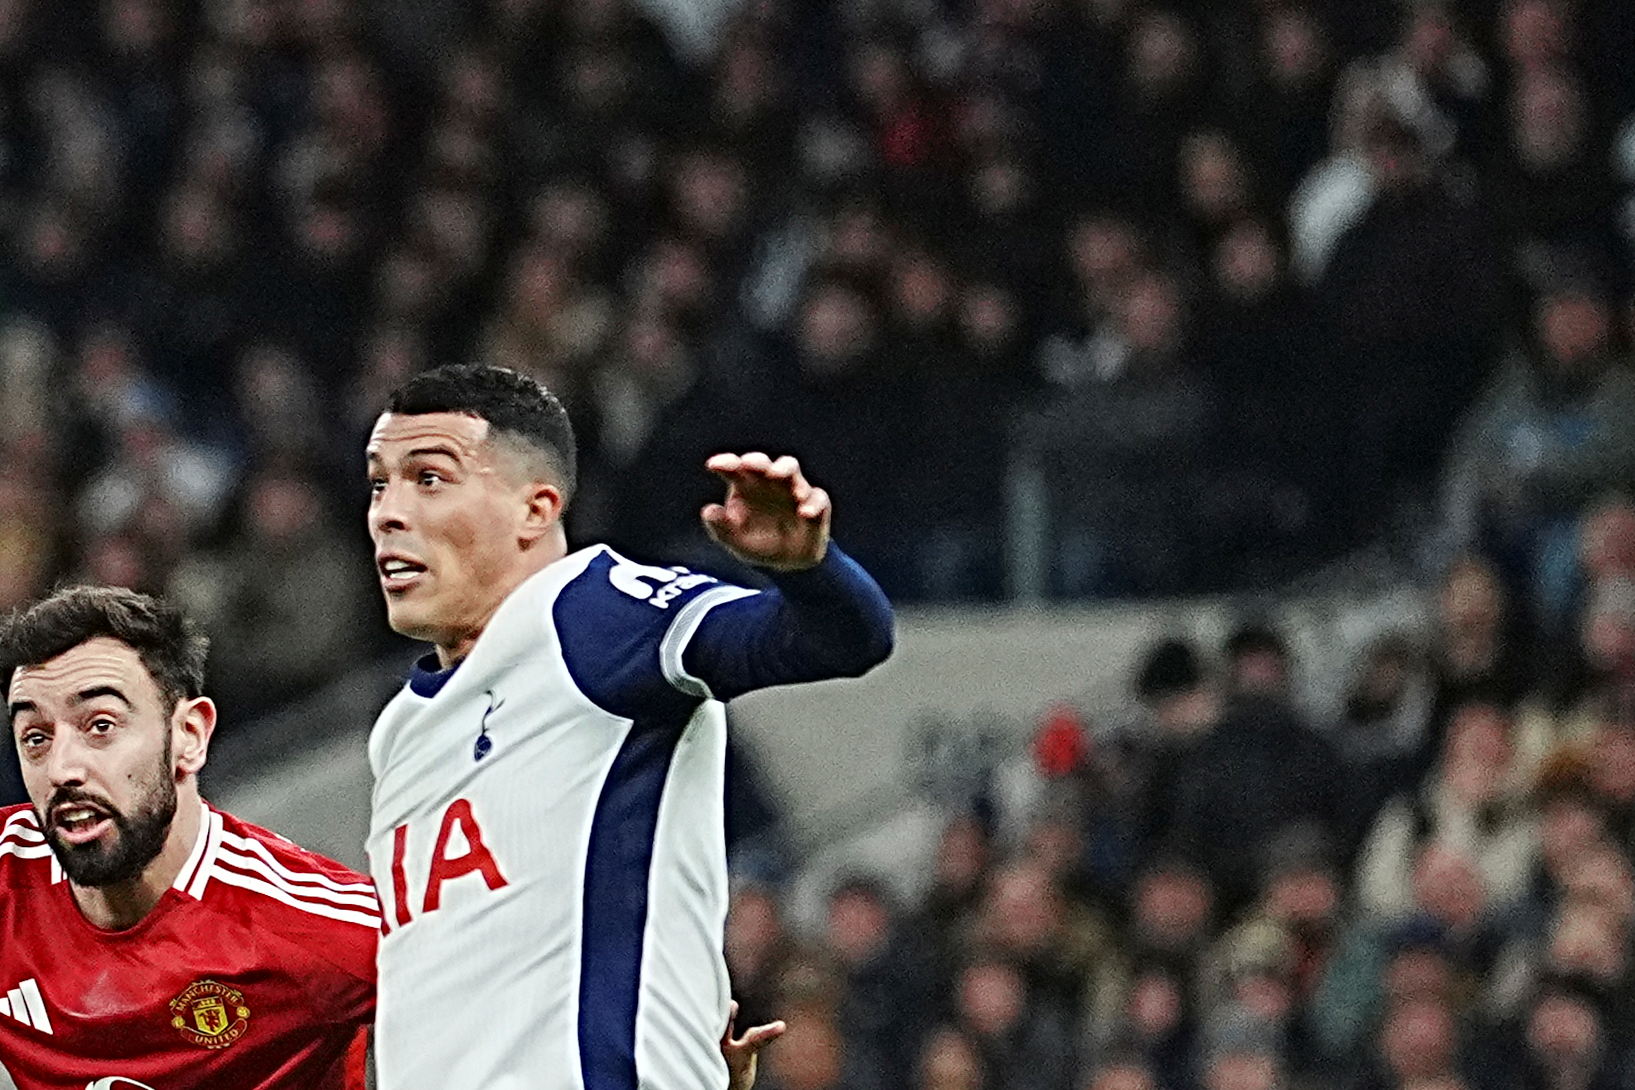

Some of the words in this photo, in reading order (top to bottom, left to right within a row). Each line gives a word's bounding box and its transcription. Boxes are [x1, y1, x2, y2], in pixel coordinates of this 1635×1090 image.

[381, 798, 510, 938] IA
[175, 984, 239, 1012] MANCHESTER
[194, 1028, 239, 1045] UNITED
